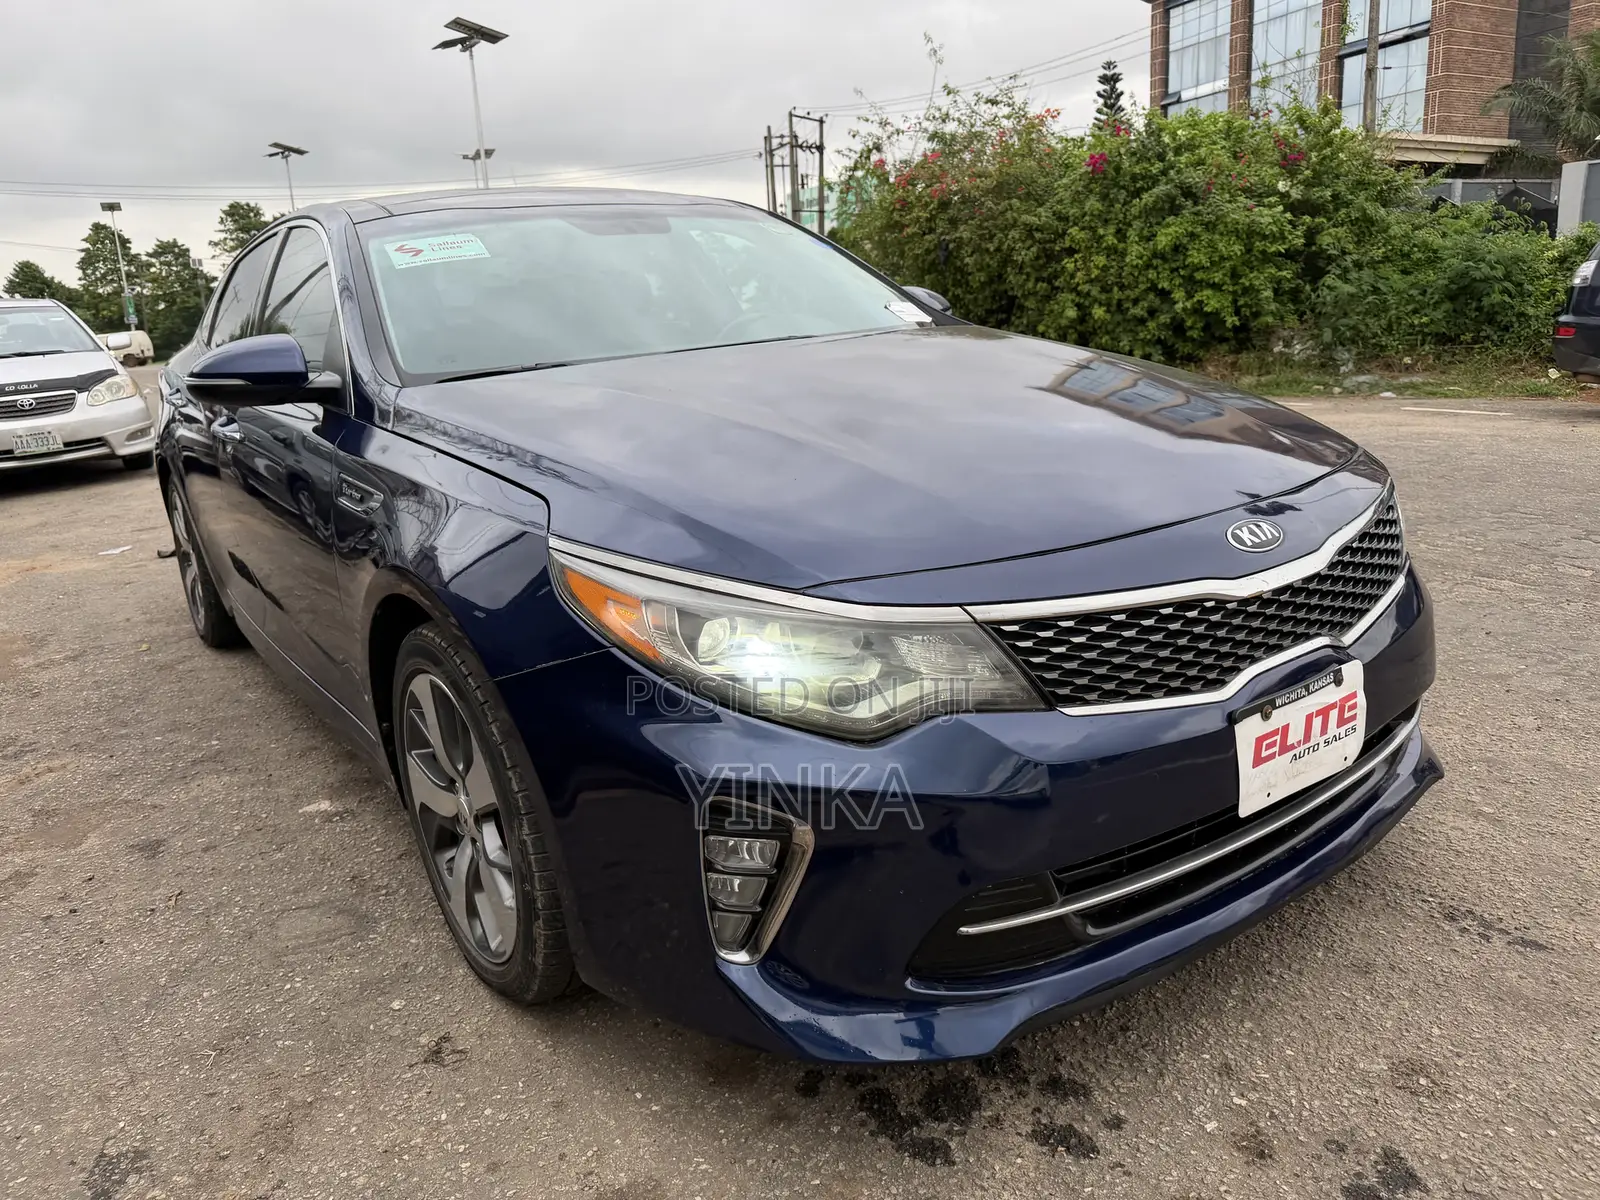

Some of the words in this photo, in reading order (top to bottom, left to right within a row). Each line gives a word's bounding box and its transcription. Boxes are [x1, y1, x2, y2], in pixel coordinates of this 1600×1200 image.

[1232, 521, 1280, 547] KIA
[1275, 688, 1309, 707] WICHITA,
[1309, 672, 1335, 692] KANSAS
[1252, 690, 1358, 769] ELITE
[1289, 742, 1320, 764] AUTO
[1323, 724, 1357, 748] SALES
